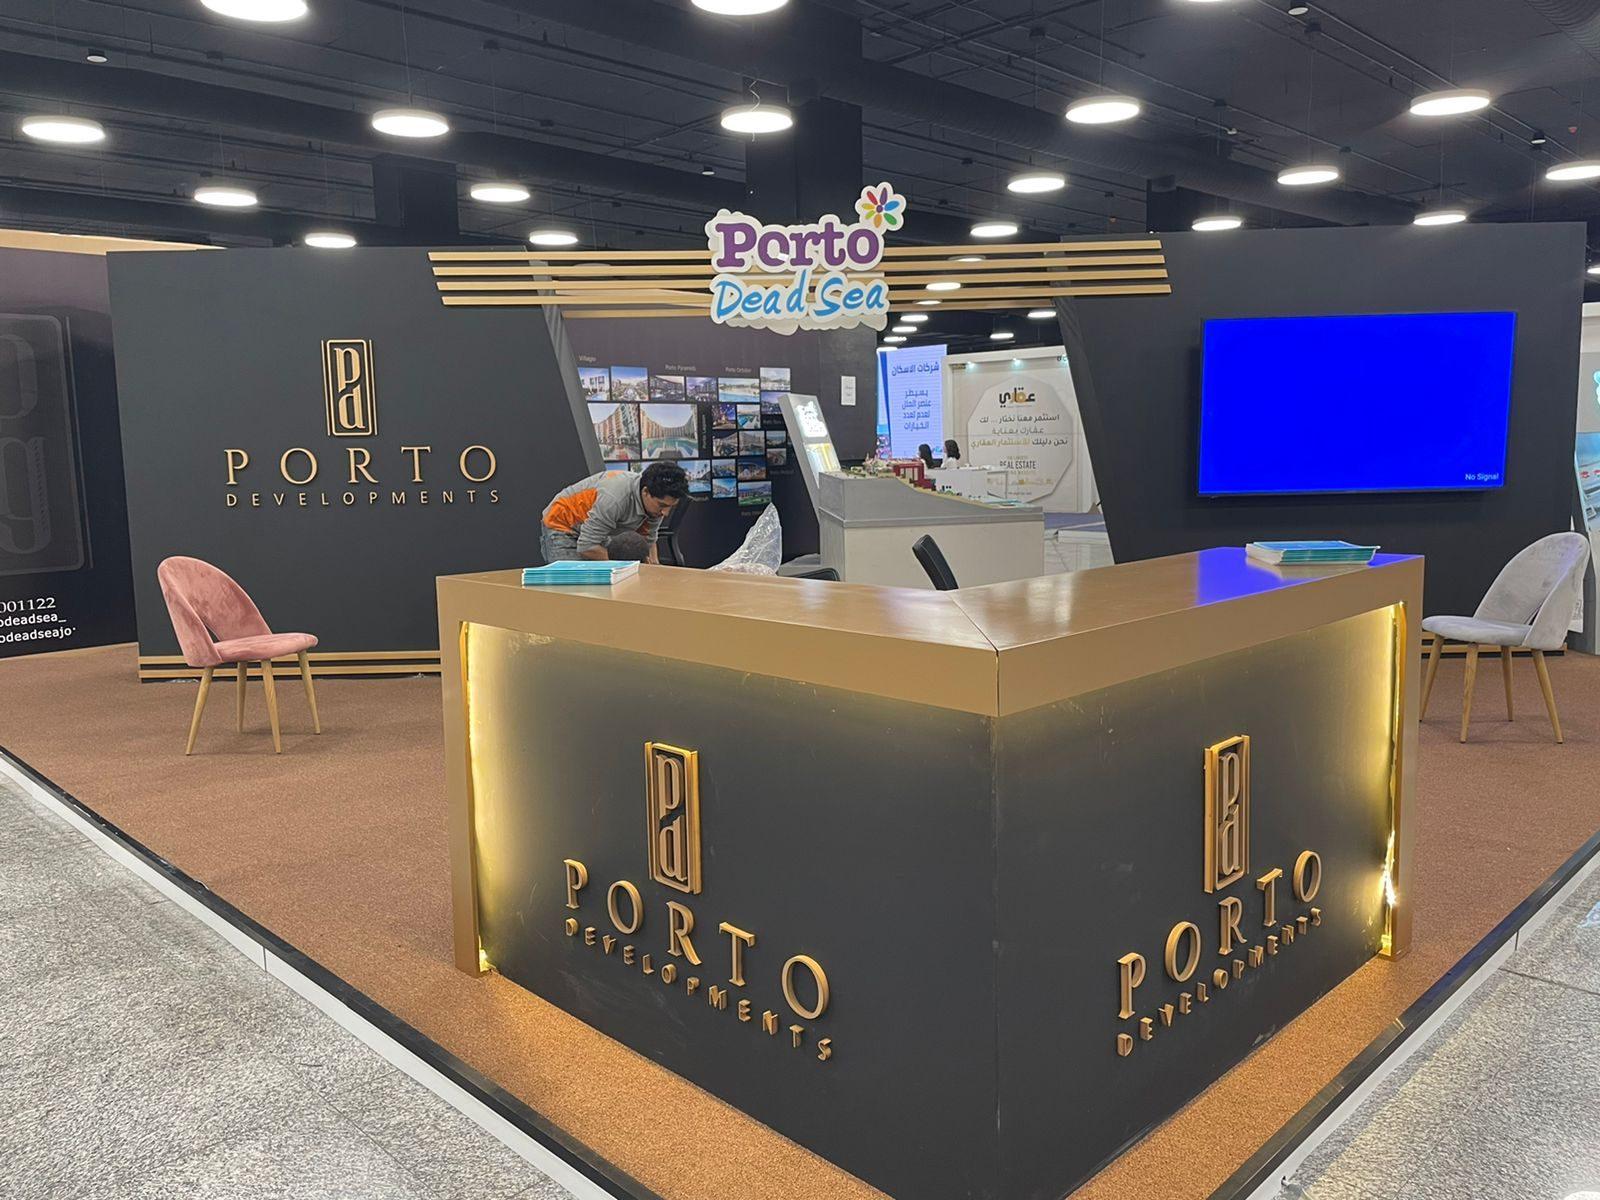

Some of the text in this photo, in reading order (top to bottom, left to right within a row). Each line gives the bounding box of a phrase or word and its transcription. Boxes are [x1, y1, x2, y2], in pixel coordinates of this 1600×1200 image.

[715, 221, 880, 268] Porto
[715, 268, 885, 319] Dead Sea
[223, 445, 498, 486] PORTO
[1015, 460, 1037, 470] ESTATE
[1476, 472, 1499, 482] Signal
[226, 489, 499, 507] DEVELOPMENTS
[563, 858, 830, 1020] PORTO
[1117, 850, 1322, 1020] PORTO
[565, 917, 833, 1062] DEVELOPMENTS
[1116, 906, 1322, 1057] DEVELOPMENTS
